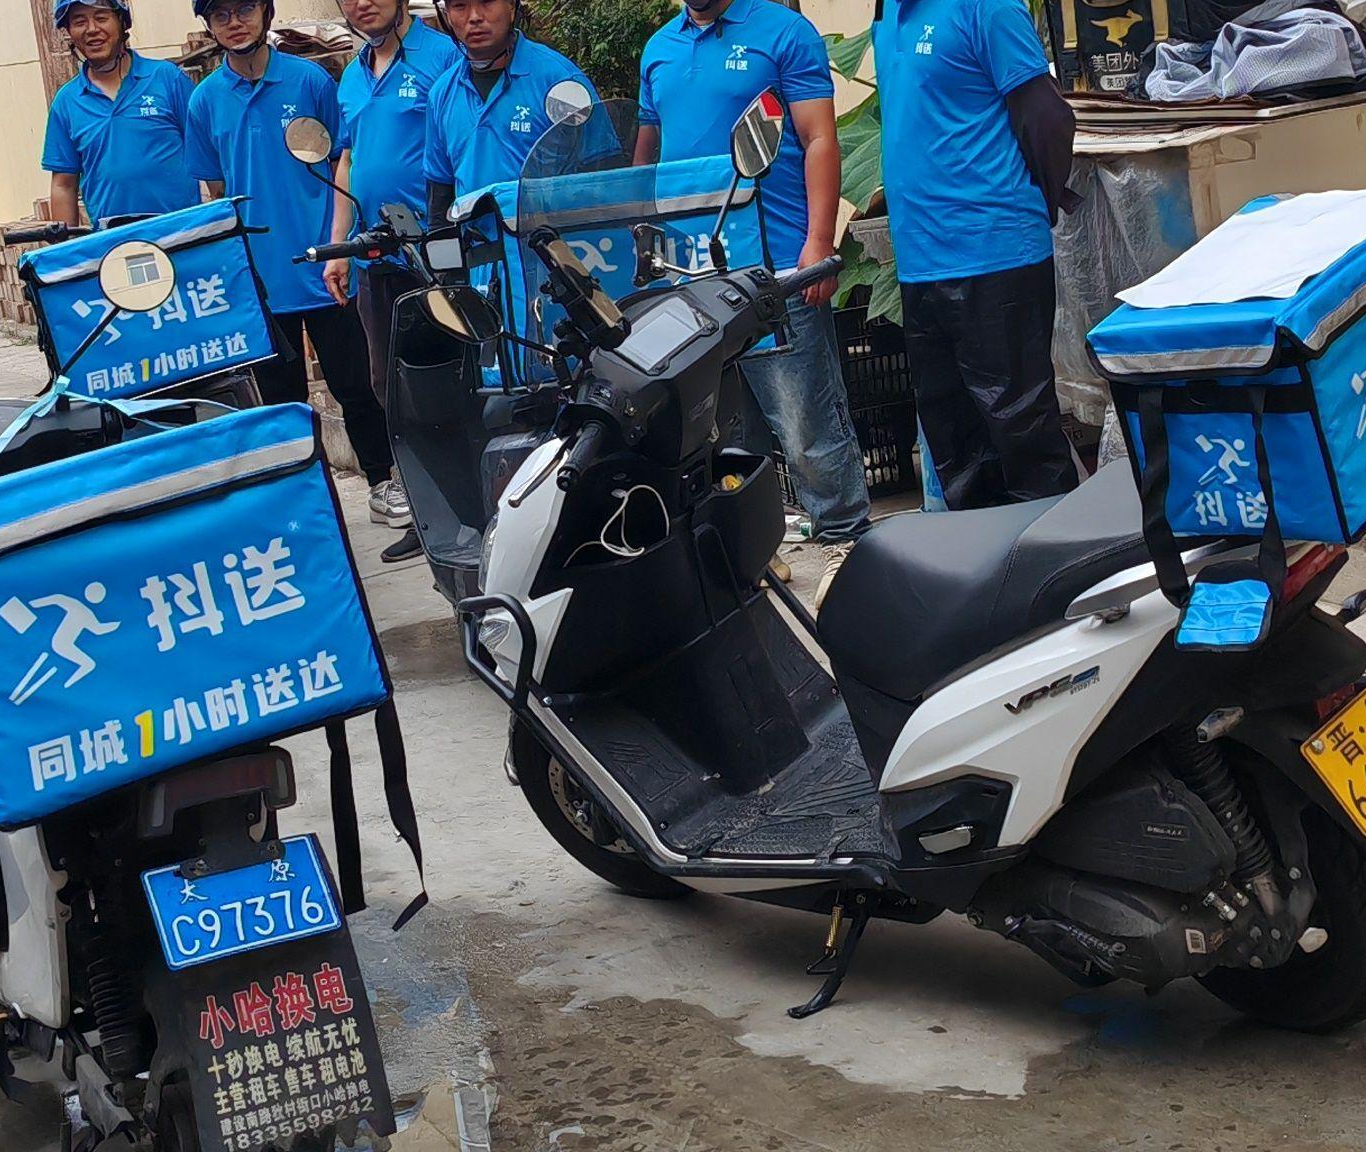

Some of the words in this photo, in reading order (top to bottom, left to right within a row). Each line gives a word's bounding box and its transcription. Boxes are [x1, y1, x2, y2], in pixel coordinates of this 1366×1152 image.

[86, 332, 249, 395] 同城1小时送达
[140, 536, 306, 652] 抖送
[28, 650, 343, 791] 同城1小时送达
[172, 885, 324, 954] C97376
[199, 962, 353, 1049] 小哈换电
[208, 1040, 283, 1084] 十秒换电
[286, 1017, 360, 1061] 续航无忧
[222, 1096, 375, 1152] 18335598242
